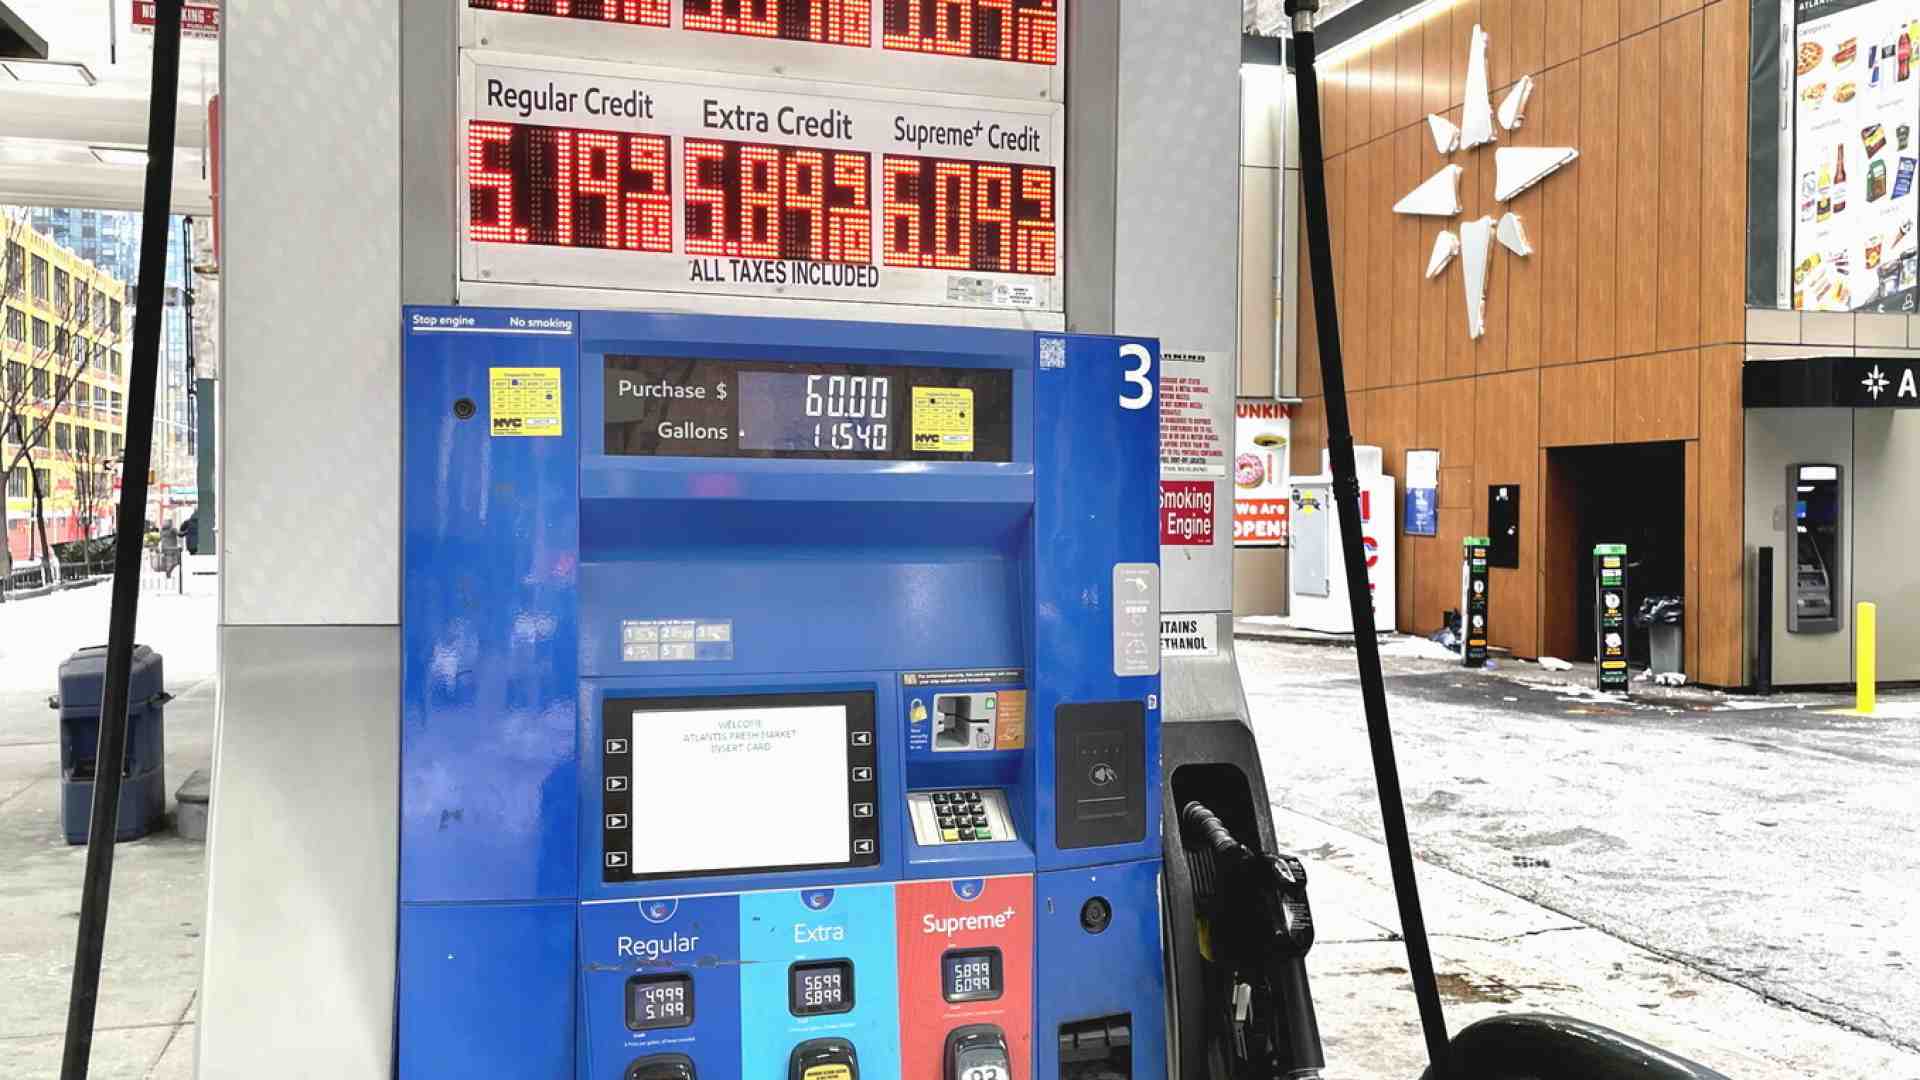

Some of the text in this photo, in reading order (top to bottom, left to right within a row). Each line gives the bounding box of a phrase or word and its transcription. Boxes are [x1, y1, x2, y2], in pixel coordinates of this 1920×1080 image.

[488, 79, 653, 119] Regular Credit
[703, 99, 853, 140] Extra Credit
[895, 116, 1040, 152] Supreme+ Credit
[689, 259, 880, 288] ALL TAXES INCLUDED
[413, 314, 475, 327] Stop engine
[510, 317, 572, 330] No smoking
[1119, 343, 1153, 410] 3
[1897, 368, 1917, 398] A
[618, 380, 728, 400] Purchase $
[805, 375, 888, 418] 60.00
[494, 418, 522, 428] NYC
[1237, 403, 1292, 419] UNKIN
[658, 421, 728, 439] Gallons
[915, 433, 940, 443] NYC
[1236, 503, 1285, 515] We Are
[1168, 512, 1211, 539] Engine
[1234, 520, 1287, 537] OPEN!
[793, 922, 844, 944] Extra
[923, 906, 1016, 937] Supreme+
[617, 931, 699, 960] Regular
